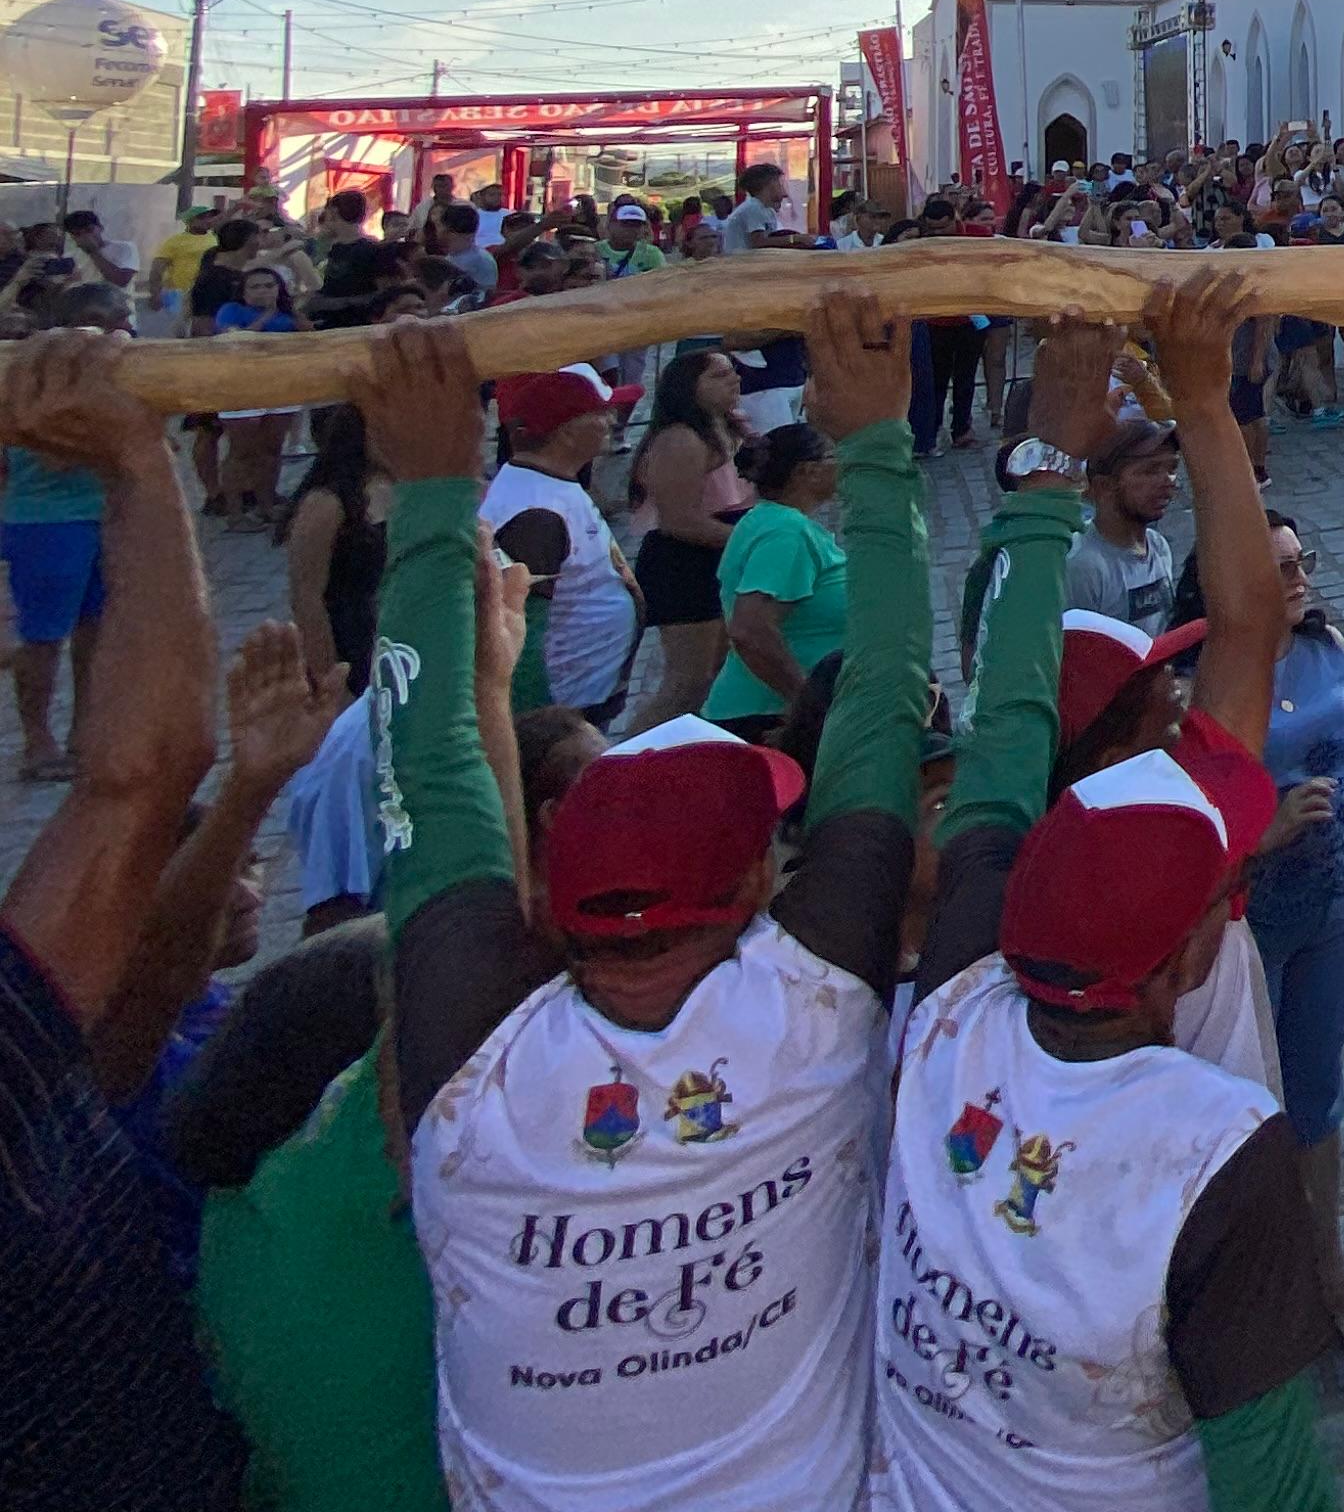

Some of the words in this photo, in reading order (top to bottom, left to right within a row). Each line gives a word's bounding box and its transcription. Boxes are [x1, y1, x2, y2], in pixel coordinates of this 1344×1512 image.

[510, 1156, 813, 1268] Homens
[556, 1280, 650, 1332] de
[662, 1239, 764, 1326] Fé
[509, 1364, 602, 1391] Nova
[616, 1286, 798, 1378] Olinda/CE
